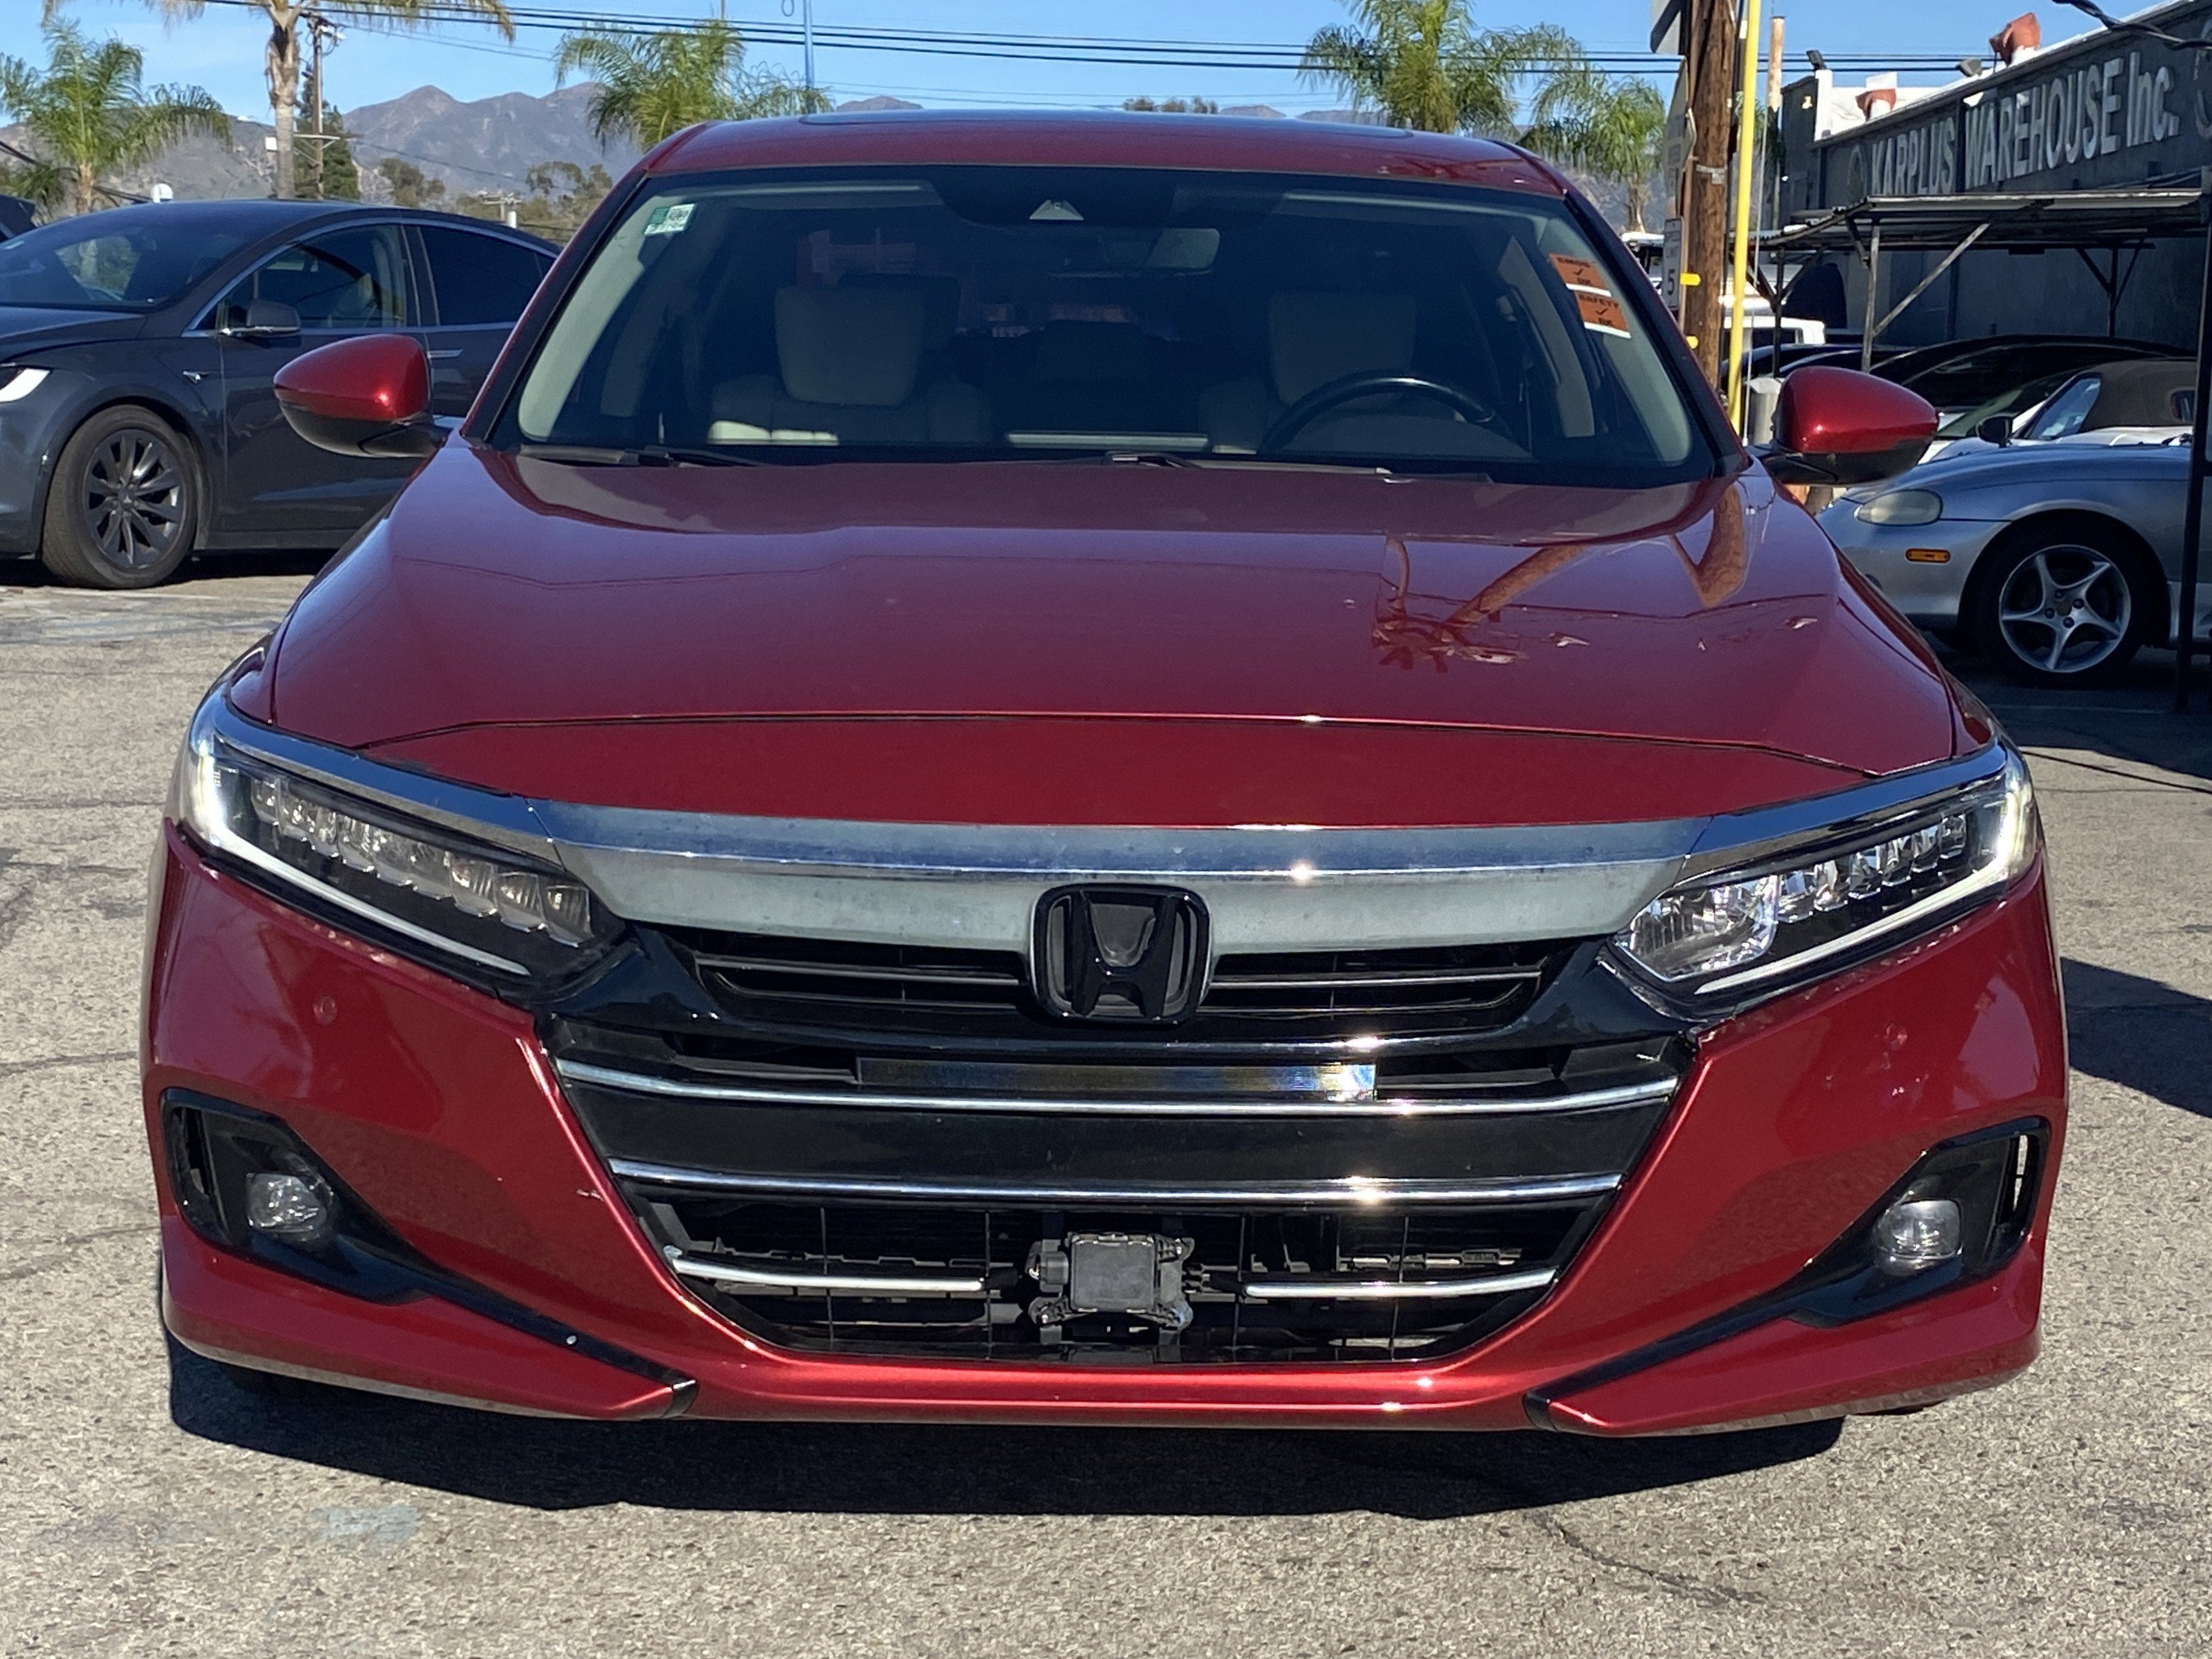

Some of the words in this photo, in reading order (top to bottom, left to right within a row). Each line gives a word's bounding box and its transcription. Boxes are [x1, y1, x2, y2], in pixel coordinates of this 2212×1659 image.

[1872, 117, 1955, 195] KARPLUS
[1965, 57, 2125, 190] WAREHOUSE
[2126, 51, 2181, 147] Inc.
[1666, 268, 1676, 296] 5
